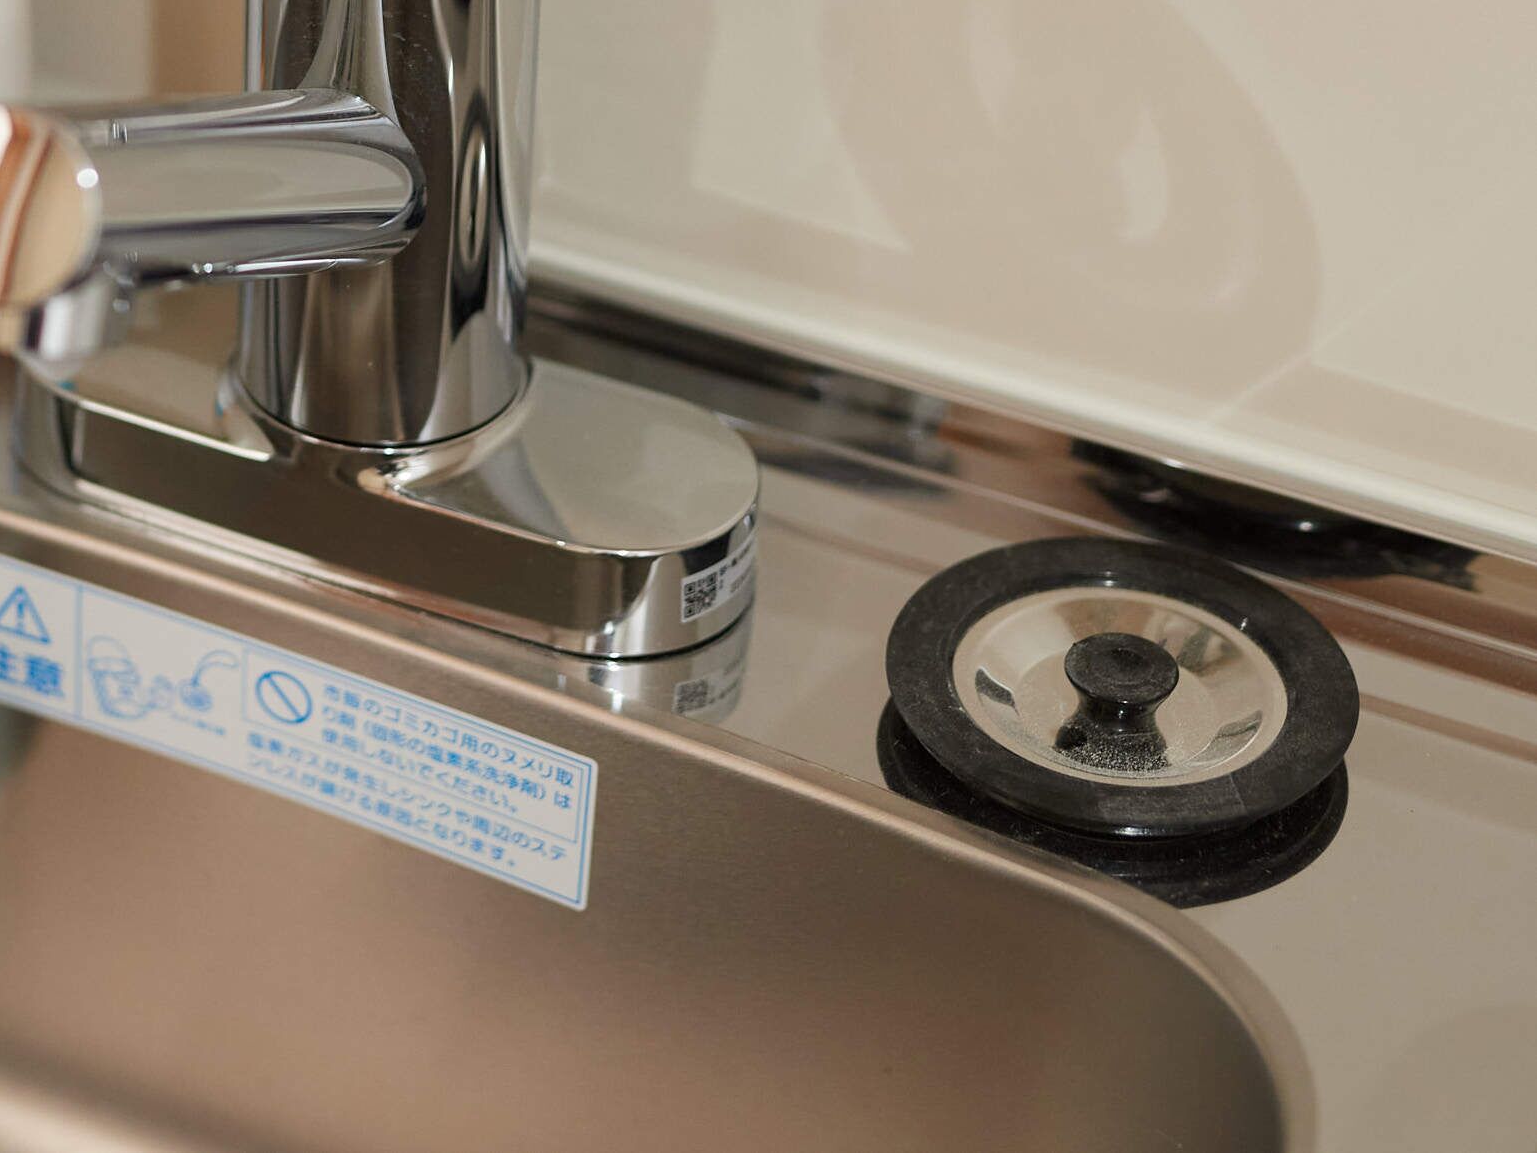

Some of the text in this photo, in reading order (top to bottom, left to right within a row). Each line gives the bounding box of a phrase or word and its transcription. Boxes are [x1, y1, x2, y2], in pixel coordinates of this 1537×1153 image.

[322, 727, 518, 813] 使用しないでください。
[324, 684, 574, 788] 市販のゴミカゴ用のヌメリ取
